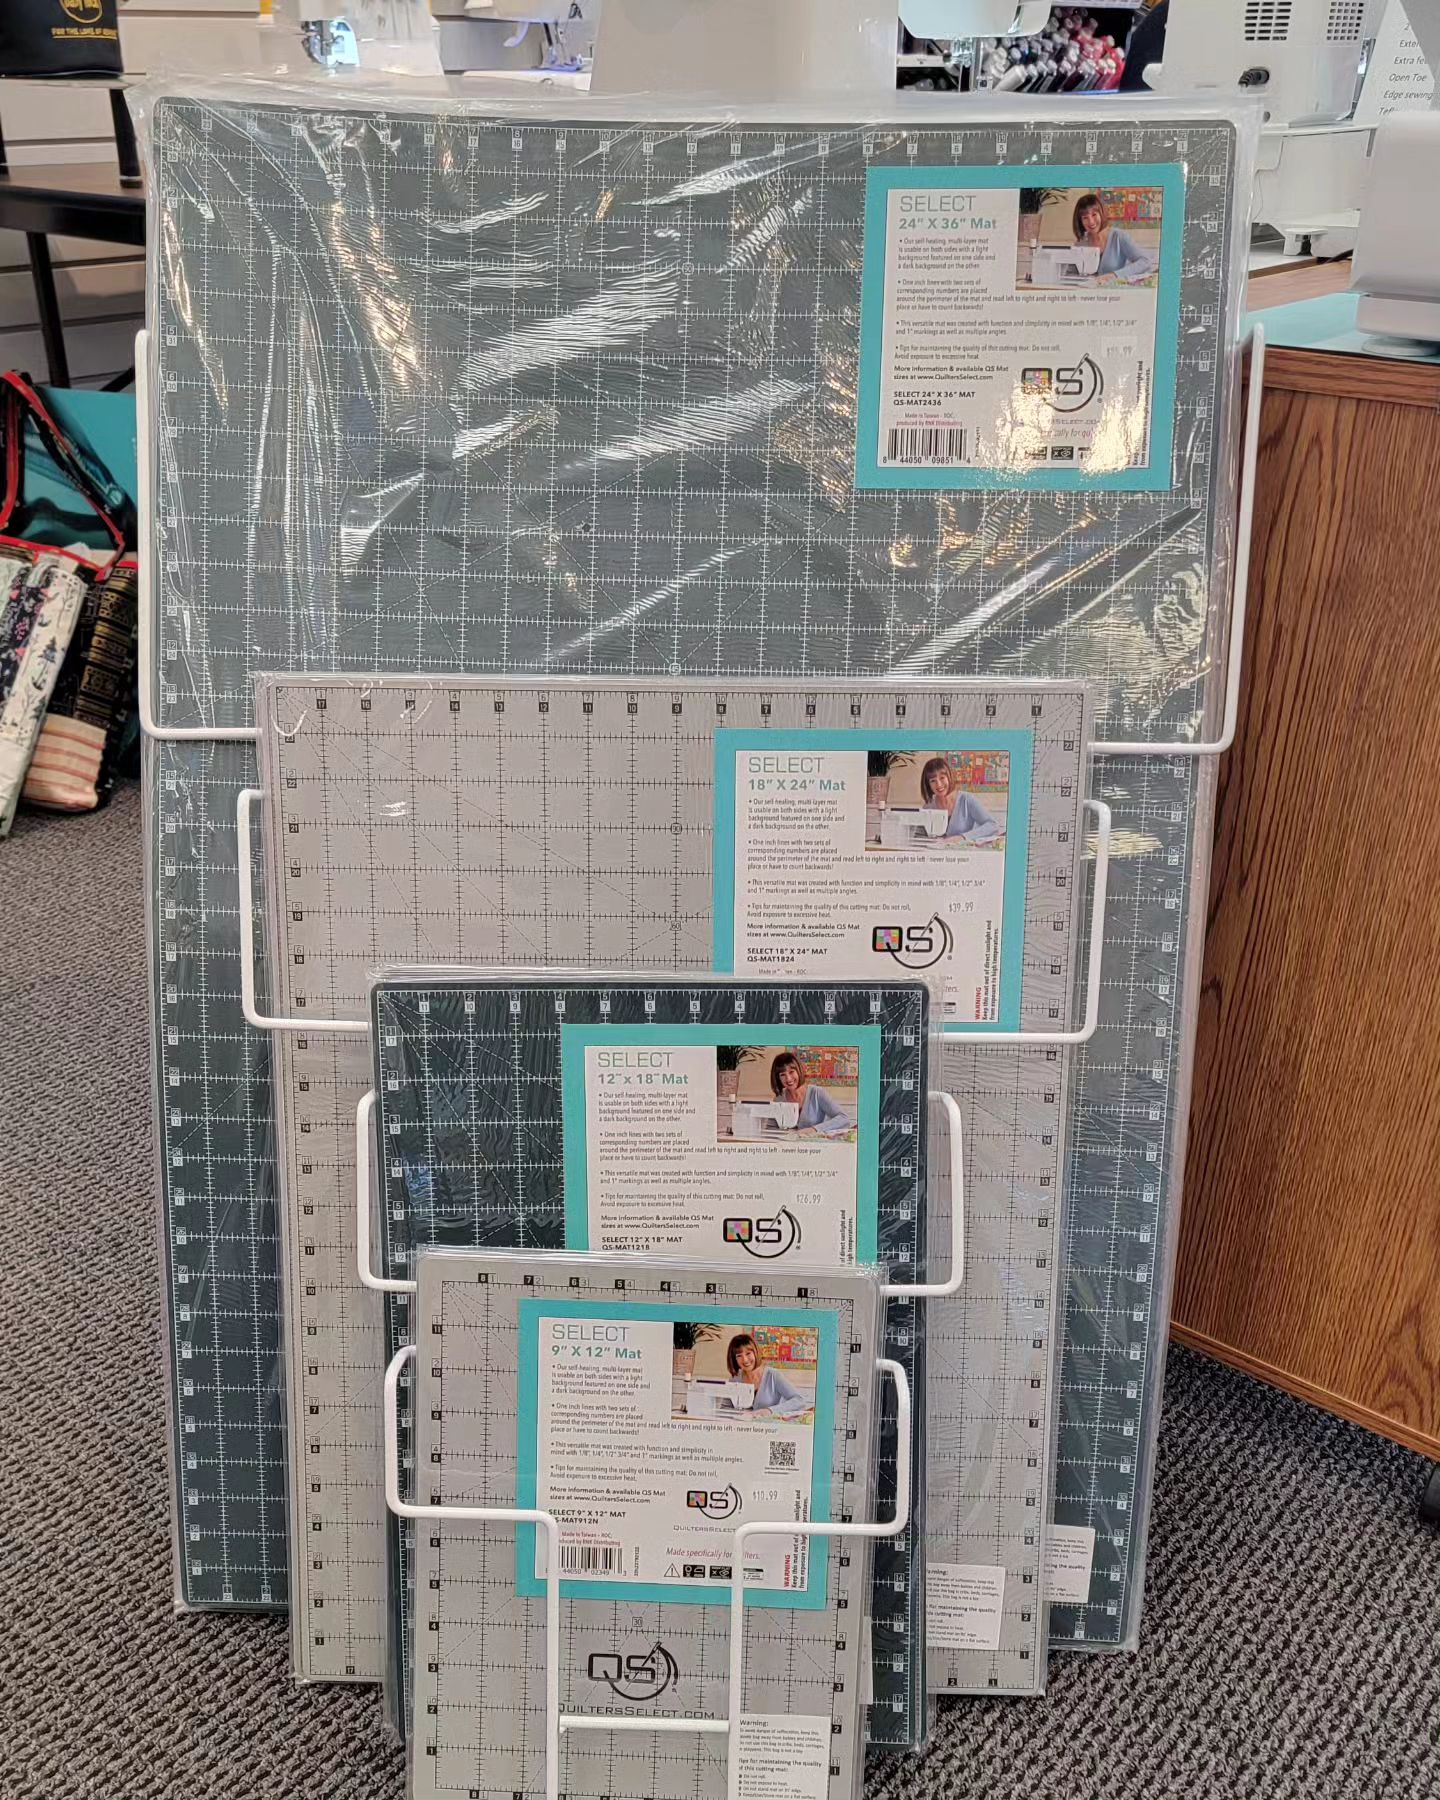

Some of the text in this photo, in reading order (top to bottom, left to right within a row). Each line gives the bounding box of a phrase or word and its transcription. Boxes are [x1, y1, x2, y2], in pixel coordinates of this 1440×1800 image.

[1394, 56, 1426, 64] Extra fe
[1389, 74, 1410, 83] Open
[1384, 91, 1433, 100] Edge sewing
[899, 194, 976, 212] SELECT
[927, 217, 937, 229] X
[970, 217, 996, 229] Mat
[748, 756, 824, 773] SELECT
[776, 778, 786, 790] X
[819, 779, 846, 790] Mat
[948, 901, 974, 912] $39.99
[872, 925, 943, 966] QS
[597, 1051, 674, 1068] SELECT
[623, 1076, 632, 1084] x
[662, 1073, 688, 1084] Mat
[796, 1193, 821, 1205] $26.99
[723, 1216, 792, 1256] QS
[552, 1323, 630, 1342] SELECT
[571, 1346, 581, 1356] X
[615, 1347, 642, 1358] Mat
[752, 1489, 778, 1502] $10.99
[687, 1491, 732, 1515] QS
[666, 1548, 684, 1556] Made
[687, 1550, 720, 1559] specifically
[588, 1653, 665, 1694] QS
